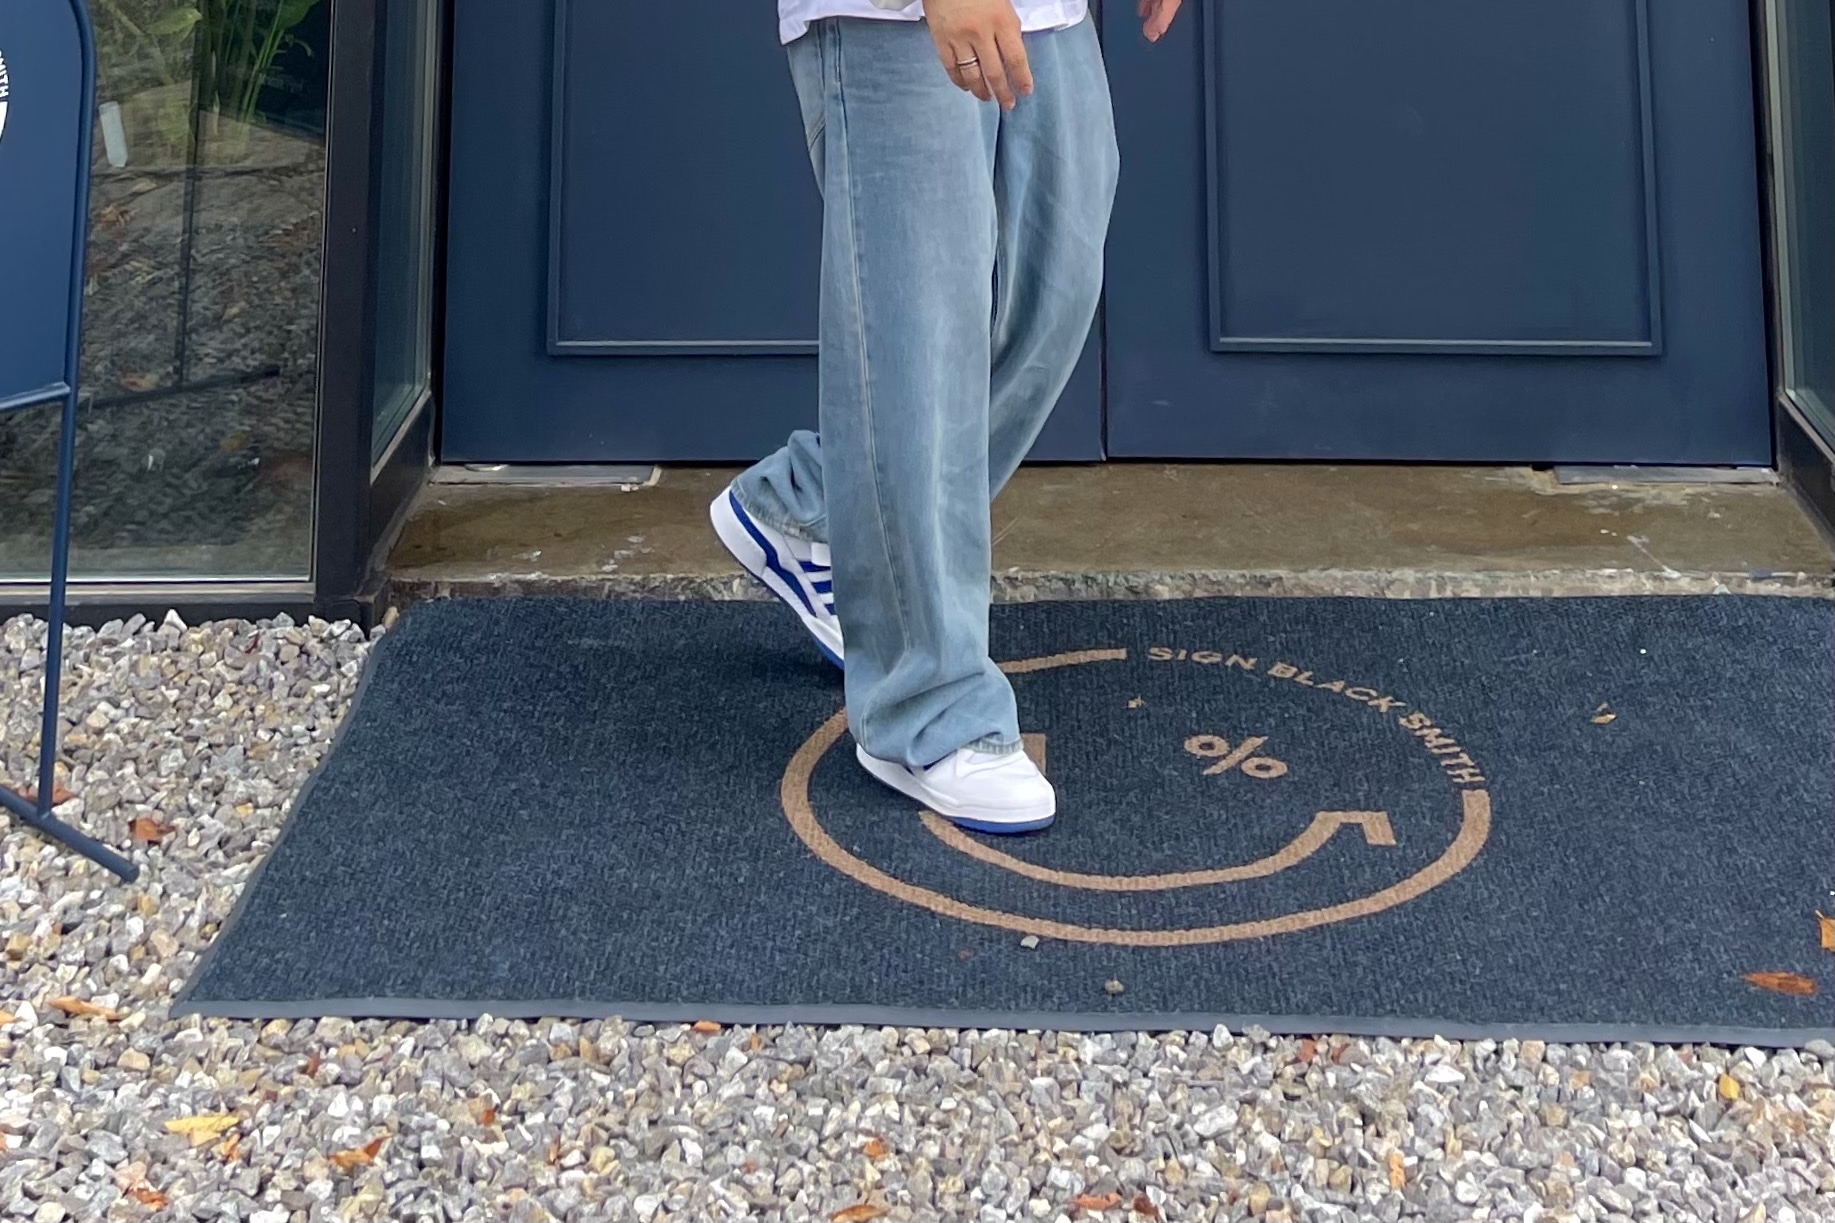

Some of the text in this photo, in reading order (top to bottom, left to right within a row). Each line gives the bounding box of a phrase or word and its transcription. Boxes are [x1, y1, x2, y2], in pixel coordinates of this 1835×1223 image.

[1148, 647, 1485, 783] SIGN BLACK SMITH
